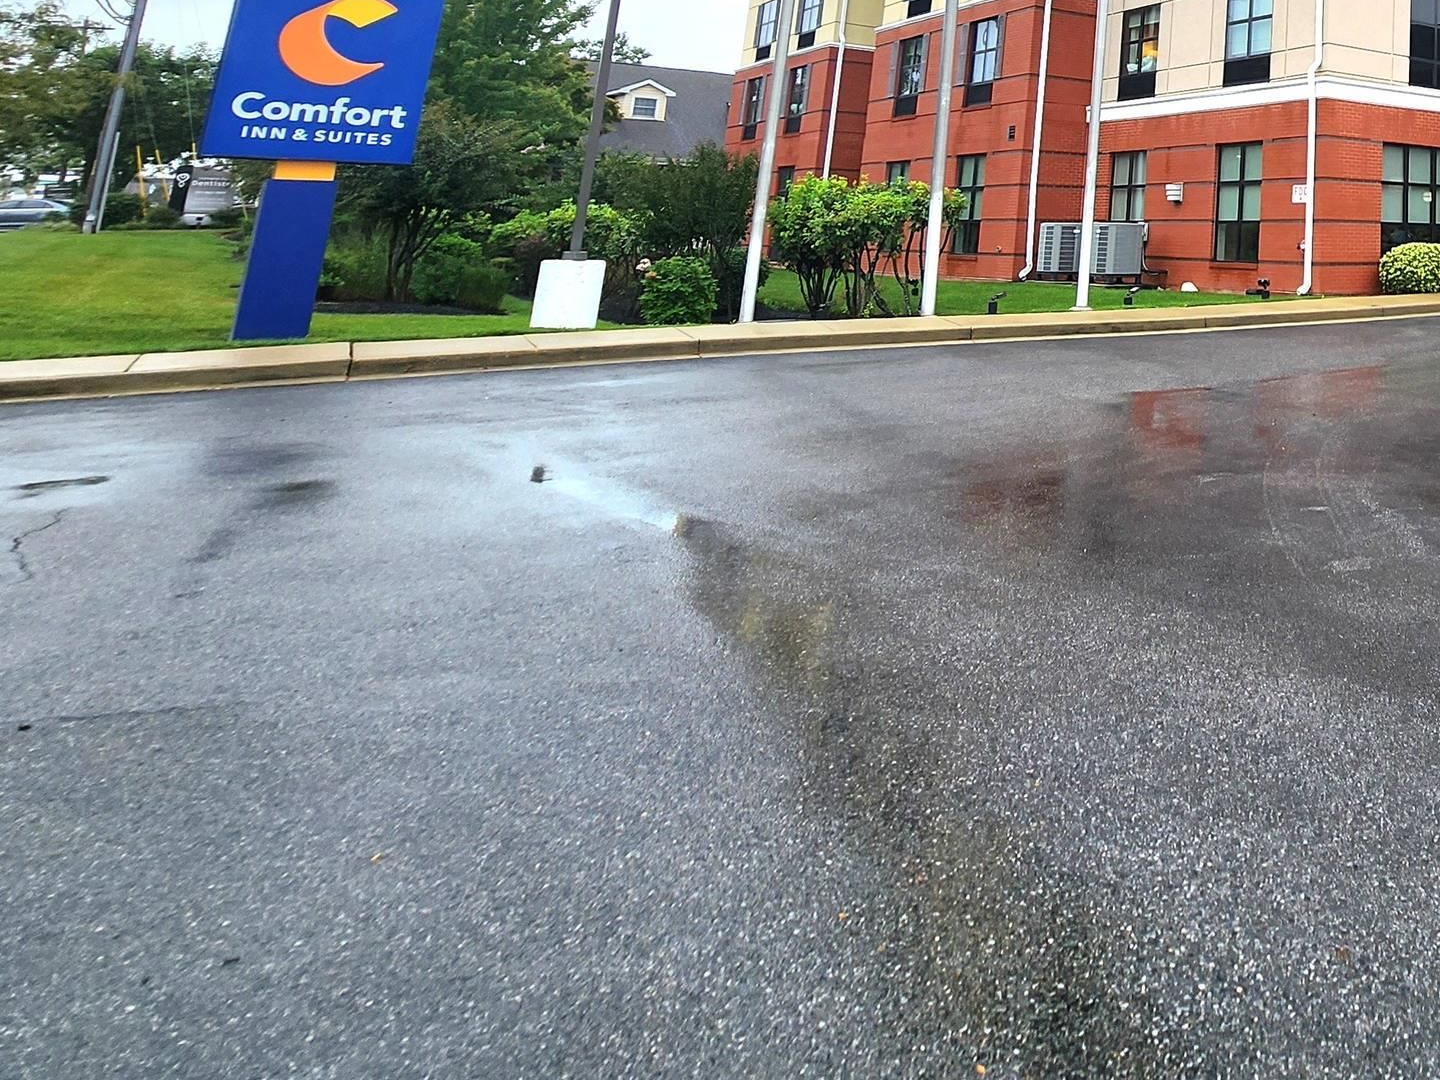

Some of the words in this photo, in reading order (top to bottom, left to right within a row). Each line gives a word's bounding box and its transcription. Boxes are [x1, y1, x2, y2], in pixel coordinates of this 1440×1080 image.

[231, 91, 407, 128] Comfort
[240, 125, 287, 140] INN
[291, 128, 308, 141] &
[313, 129, 393, 146] SUITES
